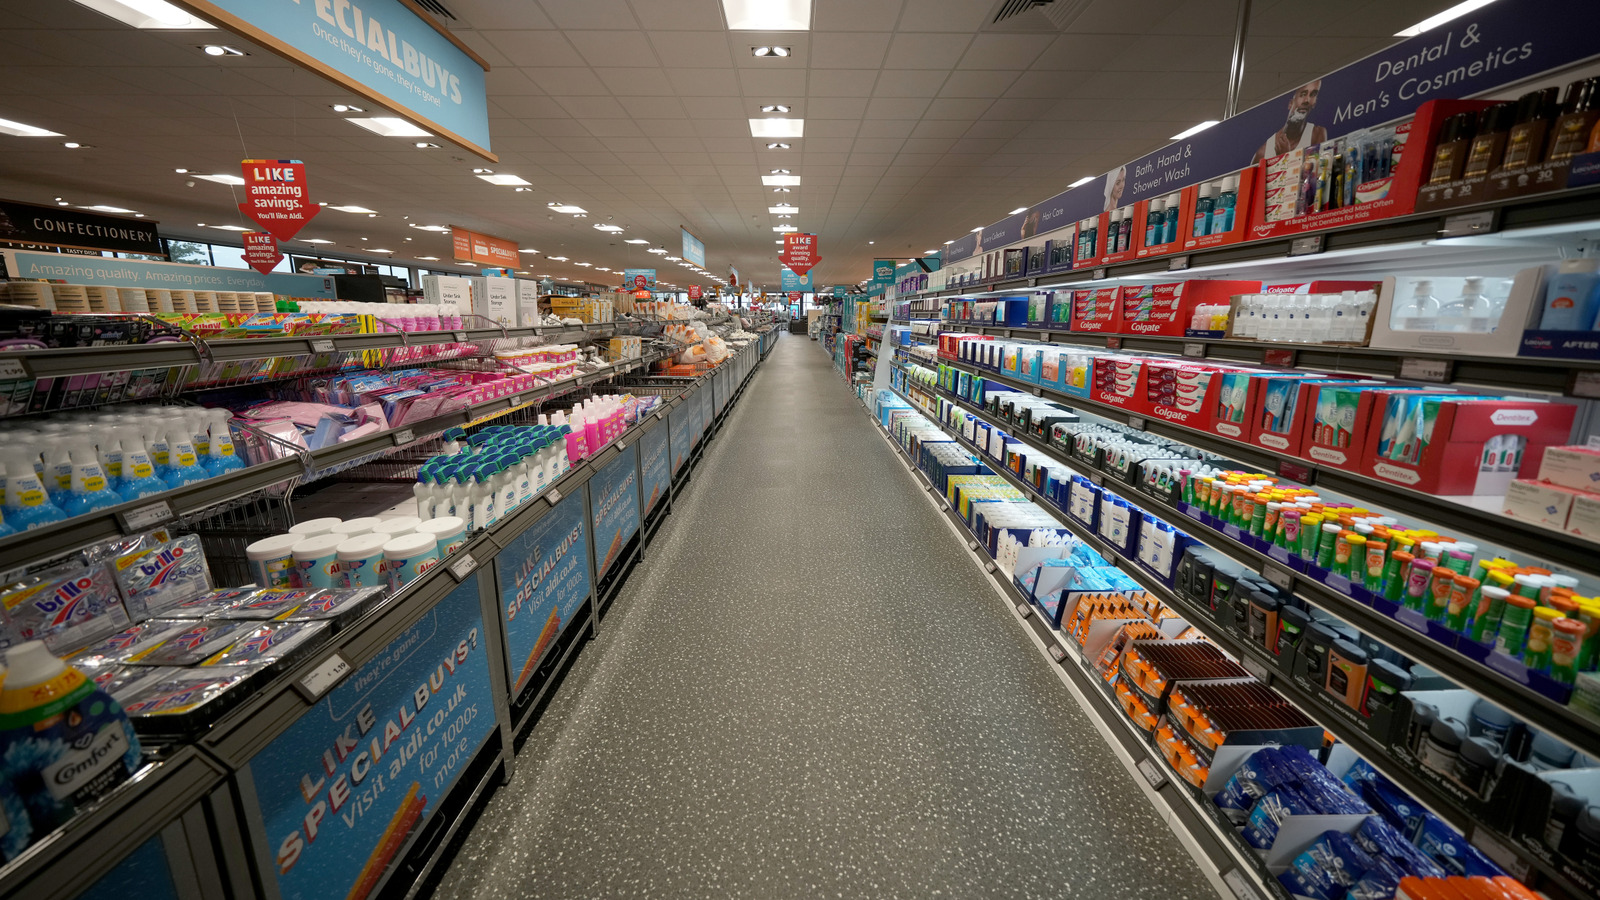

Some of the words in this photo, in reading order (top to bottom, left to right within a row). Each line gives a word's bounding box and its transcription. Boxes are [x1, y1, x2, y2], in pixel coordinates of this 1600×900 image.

[290, 0, 462, 105] ECIALBUYS
[1375, 31, 1452, 83] Dental
[1459, 23, 1481, 48] &
[312, 22, 339, 48] Once
[340, 40, 373, 66] they're
[373, 60, 397, 83] gone,
[397, 72, 423, 96] they're
[422, 88, 441, 108] gone!
[1333, 90, 1390, 126] Men's
[1398, 42, 1533, 101] Cosmetics
[1135, 160, 1155, 178] Bath,
[1156, 147, 1182, 170] Hand
[1184, 143, 1192, 157] &
[1543, 159, 1571, 170] SPRAY
[254, 167, 295, 182] LIKE
[1132, 176, 1162, 195] Shower
[1164, 162, 1191, 183] Wash
[1465, 177, 1485, 186] SPRAY
[1538, 170, 1553, 179] 30
[251, 183, 302, 198] amazing
[1356, 180, 1386, 191] Colgate
[1459, 185, 1472, 193] 30
[254, 196, 303, 211] savings.
[1052, 207, 1064, 218] Care
[1292, 217, 1308, 225] Brand
[1308, 206, 1354, 223] Recommended
[1355, 203, 1372, 211] Most
[1372, 199, 1394, 209] Often
[1309, 220, 1318, 228] UK
[1318, 216, 1344, 227] Dentists
[1354, 211, 1370, 219] Kids
[33, 218, 152, 243] CONFECTIONERY
[1253, 223, 1276, 232] Colgate
[249, 236, 271, 244] LIKE
[790, 237, 811, 245] LIKE
[247, 244, 274, 252] amazing
[30, 263, 94, 280] Amazing
[97, 267, 141, 282] quality.
[146, 271, 192, 285] Amazing
[194, 275, 224, 288] prices.
[227, 276, 266, 289] Everyday.
[1097, 289, 1112, 297] Colgate
[1154, 285, 1175, 295] Colgate
[1267, 286, 1295, 294] Colgate
[1096, 300, 1110, 308] Colgate
[1152, 298, 1172, 307] Colgate
[1095, 311, 1109, 319] Colgate
[1150, 311, 1171, 319] Colgate
[1080, 321, 1102, 330] Colgate
[1131, 322, 1161, 332] Colgate
[100, 331, 123, 339] minky
[1562, 341, 1599, 349] AFTER
[1176, 384, 1195, 392] Colgate
[1100, 391, 1125, 404] Colgate
[1153, 405, 1187, 421] Colgate
[1496, 414, 1531, 422] Dentitex
[1219, 424, 1238, 435] Dentitex
[1261, 435, 1287, 447] Dentitex
[1312, 448, 1342, 462] Dentitex
[1378, 466, 1414, 481] Dentitex
[595, 469, 635, 528] SPECIALBUYS?
[599, 480, 613, 506] LIKE
[155, 509, 170, 518] 1.99
[139, 547, 184, 575] brillo
[515, 545, 541, 588] LIKE
[507, 521, 583, 621] SPECIALBUYS?
[528, 591, 545, 615] Visit
[545, 555, 578, 598] aldi.co.uk
[556, 587, 566, 602] for
[566, 571, 583, 593] 1000s
[35, 577, 92, 613] brillo
[261, 591, 306, 601] brillo
[563, 591, 579, 616] more
[332, 662, 347, 674] 1.19
[354, 656, 391, 693] they're
[391, 630, 420, 661] gone!
[1334, 702, 1358, 721] SHOWER
[1358, 719, 1370, 730] GEL
[418, 743, 440, 775] for
[441, 702, 478, 748] 1000s
[54, 732, 121, 785] Comfort
[276, 627, 478, 876] SPECIALBUYS?
[300, 702, 377, 805] LIKE
[342, 773, 386, 829] Visit
[389, 683, 468, 779] aldi.co.uk
[434, 736, 468, 790] more
[1419, 764, 1441, 782] BODY
[1442, 780, 1468, 801] SPRAY
[1563, 865, 1594, 891] BODY
